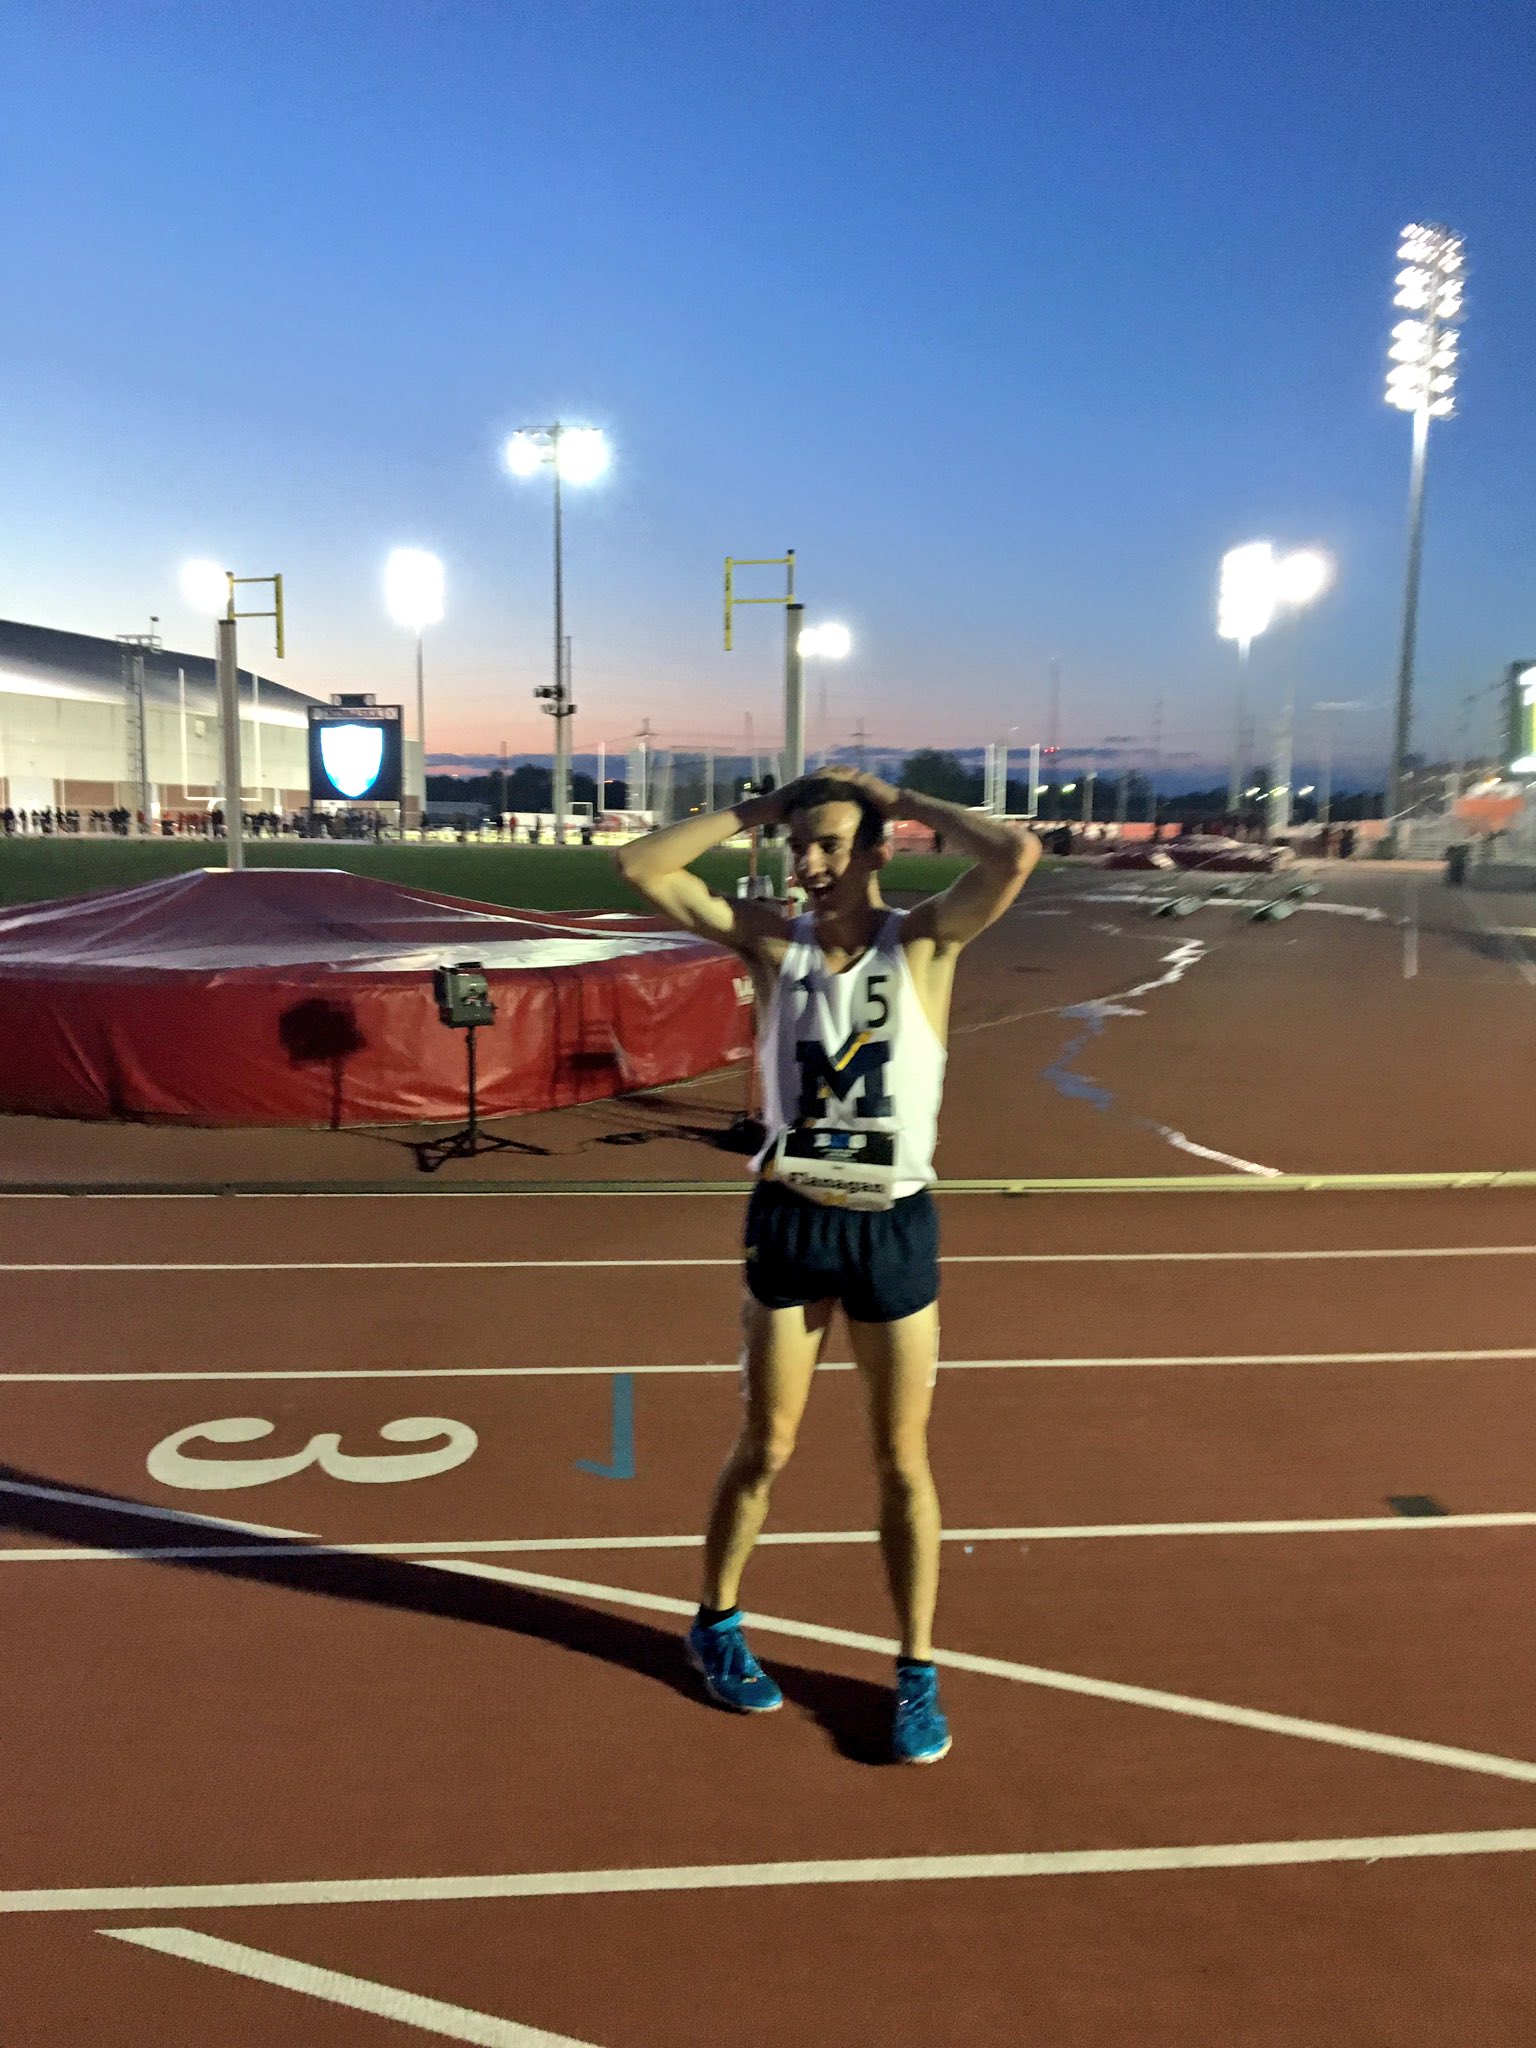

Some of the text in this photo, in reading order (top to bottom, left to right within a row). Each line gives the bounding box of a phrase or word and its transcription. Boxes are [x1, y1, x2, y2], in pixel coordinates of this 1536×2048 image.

[866, 975, 890, 1028] 5
[796, 1039, 893, 1118] M
[147, 1416, 479, 1490] 3
